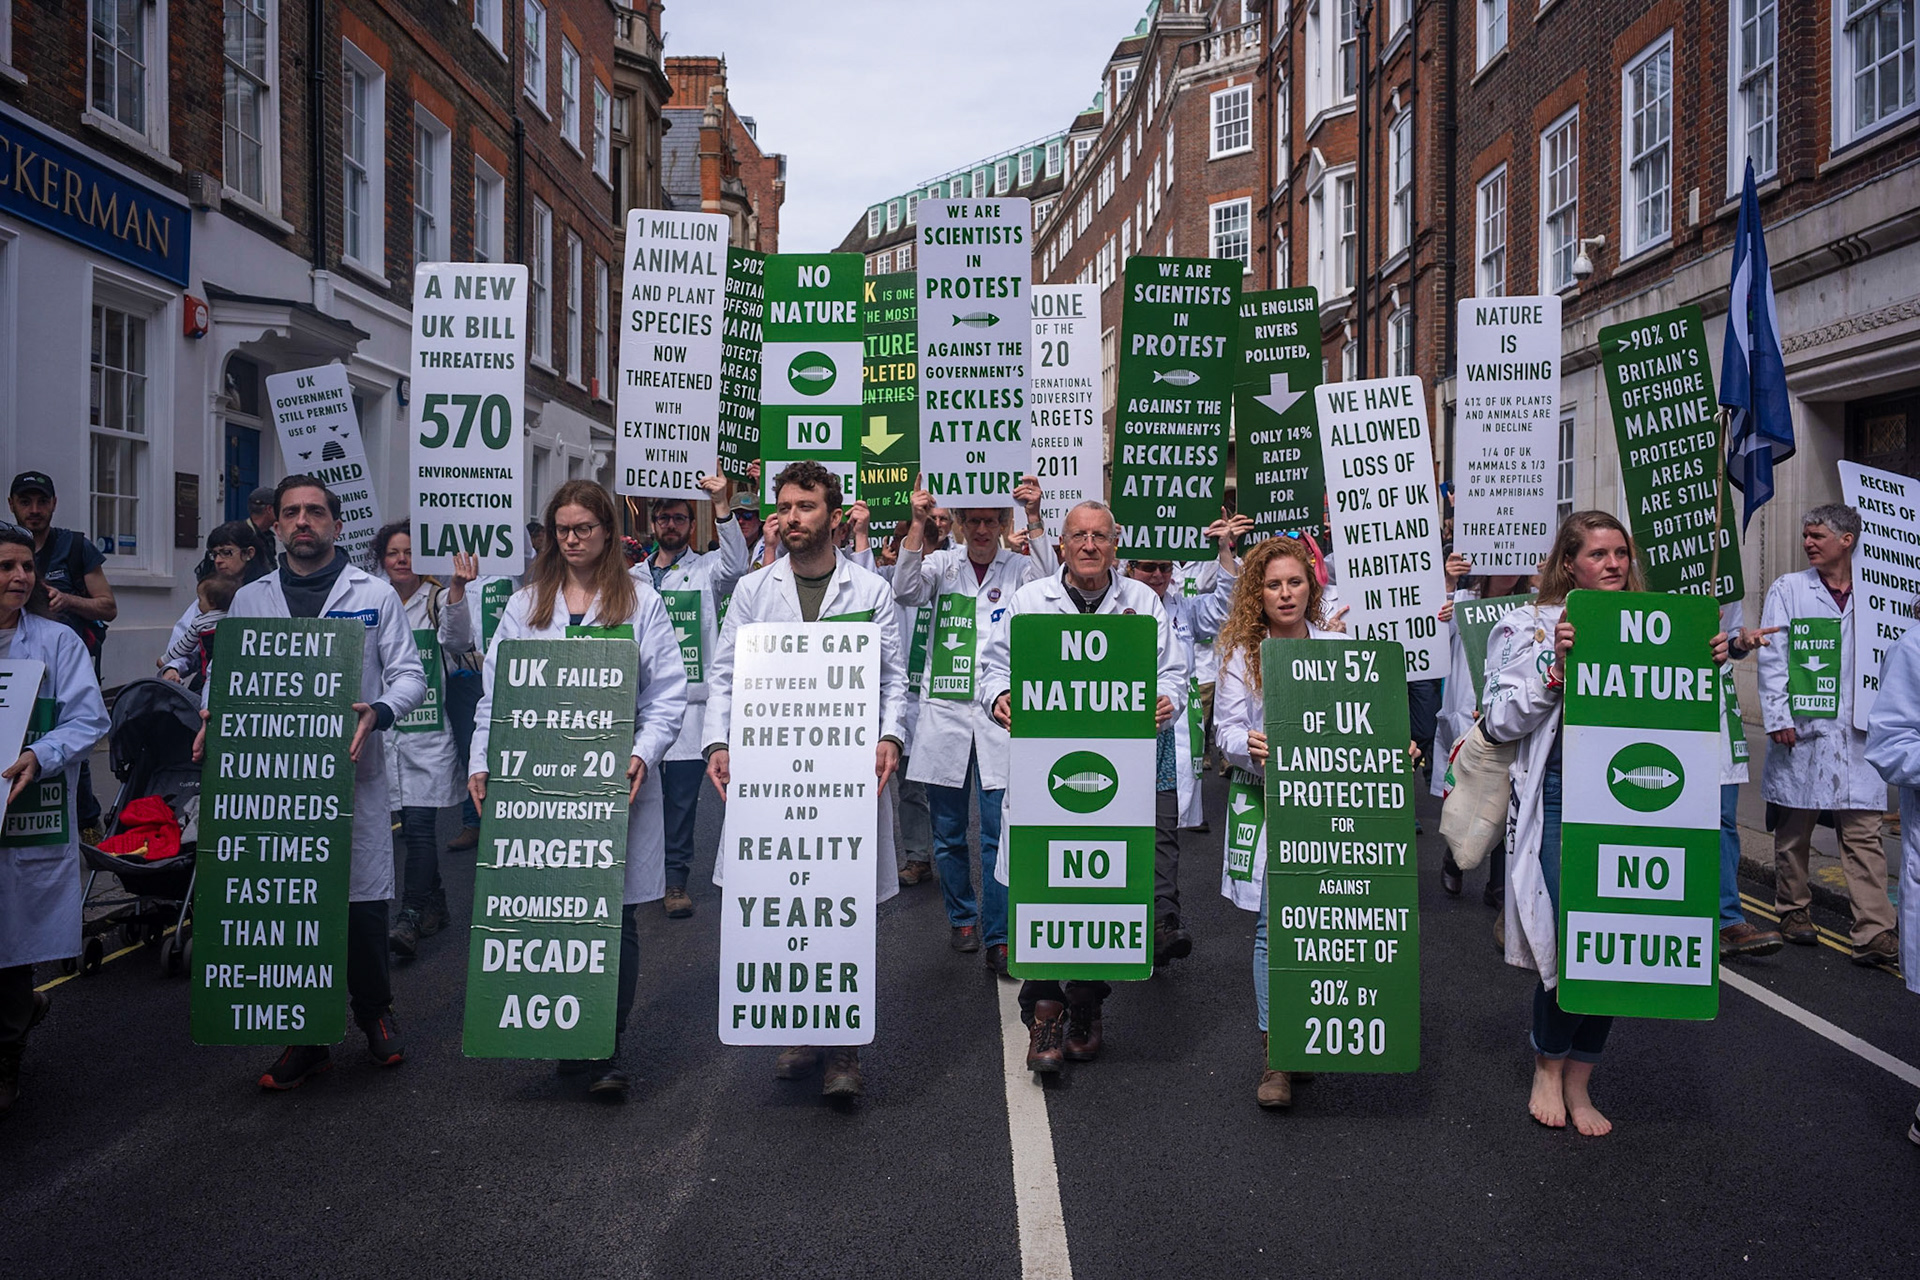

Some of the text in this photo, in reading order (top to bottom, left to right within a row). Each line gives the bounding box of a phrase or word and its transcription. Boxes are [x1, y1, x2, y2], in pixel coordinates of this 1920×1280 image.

[947, 205, 1000, 218] WE ARE
[638, 218, 717, 241] 1 MILLION
[925, 226, 1022, 245] SCIENTISTS
[633, 248, 717, 275] ANIMAL
[1159, 264, 1211, 278] WE ARE
[798, 265, 830, 287] NO
[632, 285, 715, 304] AND PLANT
[883, 289, 914, 301] IS ONE
[927, 277, 1021, 298] PROTEST
[1135, 284, 1230, 305] SCIENTISTS
[771, 301, 856, 323] NATURE
[1262, 298, 1313, 315] ENGLISH
[1477, 306, 1542, 325] NATURE
[422, 315, 514, 339] UK BILL
[632, 310, 712, 335] SPECIES
[1036, 323, 1073, 335] OF THE
[1255, 322, 1297, 339] RIVERS
[1502, 335, 1516, 353] IS
[1618, 320, 1687, 352] >90% OF
[928, 342, 1021, 356] AGAINST THE
[1041, 341, 1068, 367] 20
[1246, 345, 1310, 363] POLLUTED,
[420, 352, 514, 369] THREATENS
[1618, 349, 1698, 384] BRITAIN'S
[626, 370, 712, 390] THREATENED
[926, 365, 1023, 378] GOVERNMENT'S
[1467, 361, 1551, 381] VANISHING
[297, 376, 315, 388] UK
[1623, 373, 1703, 408] OFFSHORE
[277, 389, 342, 408] GOVERNMENT
[656, 402, 681, 414] WITH
[927, 389, 1023, 409] RECKLESS
[1128, 399, 1221, 414] AGAINST THE
[1465, 396, 1551, 406] 41% OF UK PLANTS
[279, 403, 347, 423] STILL PERMITS
[420, 394, 511, 449] 570
[1466, 409, 1550, 419] AND ANIMALS ARE
[1625, 397, 1710, 440] MARINE
[289, 425, 316, 437] USE OF
[625, 421, 709, 441] EXTINCTION
[1125, 422, 1220, 435] GOVERNMENT'S
[1251, 426, 1312, 444] ONLY 14%
[1331, 417, 1420, 446] ALLOWED
[1483, 423, 1532, 432] IN DECLINE
[1031, 437, 1082, 448] AGREED IN
[1483, 447, 1530, 456] 1/4 OF UK
[1630, 431, 1715, 467] PROTECTED
[646, 448, 687, 463] WITHIN
[1263, 448, 1300, 463] RATED
[1343, 452, 1414, 478] LOSS OF
[1469, 460, 1545, 470] MAMMALS & 1/3
[419, 467, 512, 479] ENVIRONMENTAL
[1037, 456, 1076, 476] 2011
[1256, 467, 1308, 484] HEALTHY
[1652, 459, 1703, 487] AREAS
[1471, 474, 1542, 483] OF UK REPTILES
[1860, 474, 1904, 497] RECENT
[420, 493, 511, 508] PROTECTION
[1271, 489, 1293, 503] FOR
[1337, 484, 1429, 512] 90% OF UK
[1490, 488, 1543, 496] AMPHIBIANS
[1255, 507, 1309, 524] ANIMALS
[1497, 507, 1513, 515] ARE
[1858, 496, 1915, 521] RATES OF
[1344, 518, 1428, 544] WETLAND
[1463, 523, 1546, 535] THREATENED
[1654, 510, 1716, 538] BOTTOM
[1494, 541, 1514, 549] WITH
[1349, 551, 1430, 578] HABITATS
[1681, 563, 1704, 580] AND
[1794, 625, 1809, 634] NO
[241, 630, 336, 656] RECENT
[1794, 640, 1834, 650] NATURE
[509, 659, 623, 687] UK FAILED
[955, 659, 968, 669] NO
[1292, 651, 1379, 682] ONLY 5%
[745, 666, 865, 689] BETWEEN UK
[934, 679, 968, 689] FUTURE
[1578, 663, 1712, 701] NATURE
[1819, 680, 1834, 689] NO
[1023, 681, 1145, 711] NATURE
[1794, 698, 1833, 707] FUTURE
[744, 703, 866, 717] GOVERNMENT
[221, 714, 343, 737] EXTINCTION
[743, 727, 865, 746] RHETORIC
[501, 751, 615, 777] 17 OUT OF 20
[43, 787, 60, 801] NO
[739, 784, 865, 797] ENVIRONMENT
[1280, 781, 1404, 808] PROTECTED
[495, 801, 615, 820] BIODIVERSITY
[16, 815, 60, 830] FUTURE
[1238, 827, 1253, 841] NO
[493, 839, 614, 869] TARGETS
[739, 837, 862, 860] REALITY
[1280, 841, 1407, 865] BIODIVERSITY
[227, 878, 317, 903] FASTER
[1319, 880, 1370, 894] AGAINST
[738, 897, 856, 927] YEARS
[1282, 906, 1409, 931] GOVERNMENT
[221, 920, 318, 946] THAN IN
[1031, 921, 1142, 949] FUTURE
[1294, 938, 1397, 962] TARGET OF
[1577, 932, 1701, 968] FUTURE
[206, 965, 332, 988] PRE-HUMAN
[1311, 980, 1377, 1005] 30% BY
